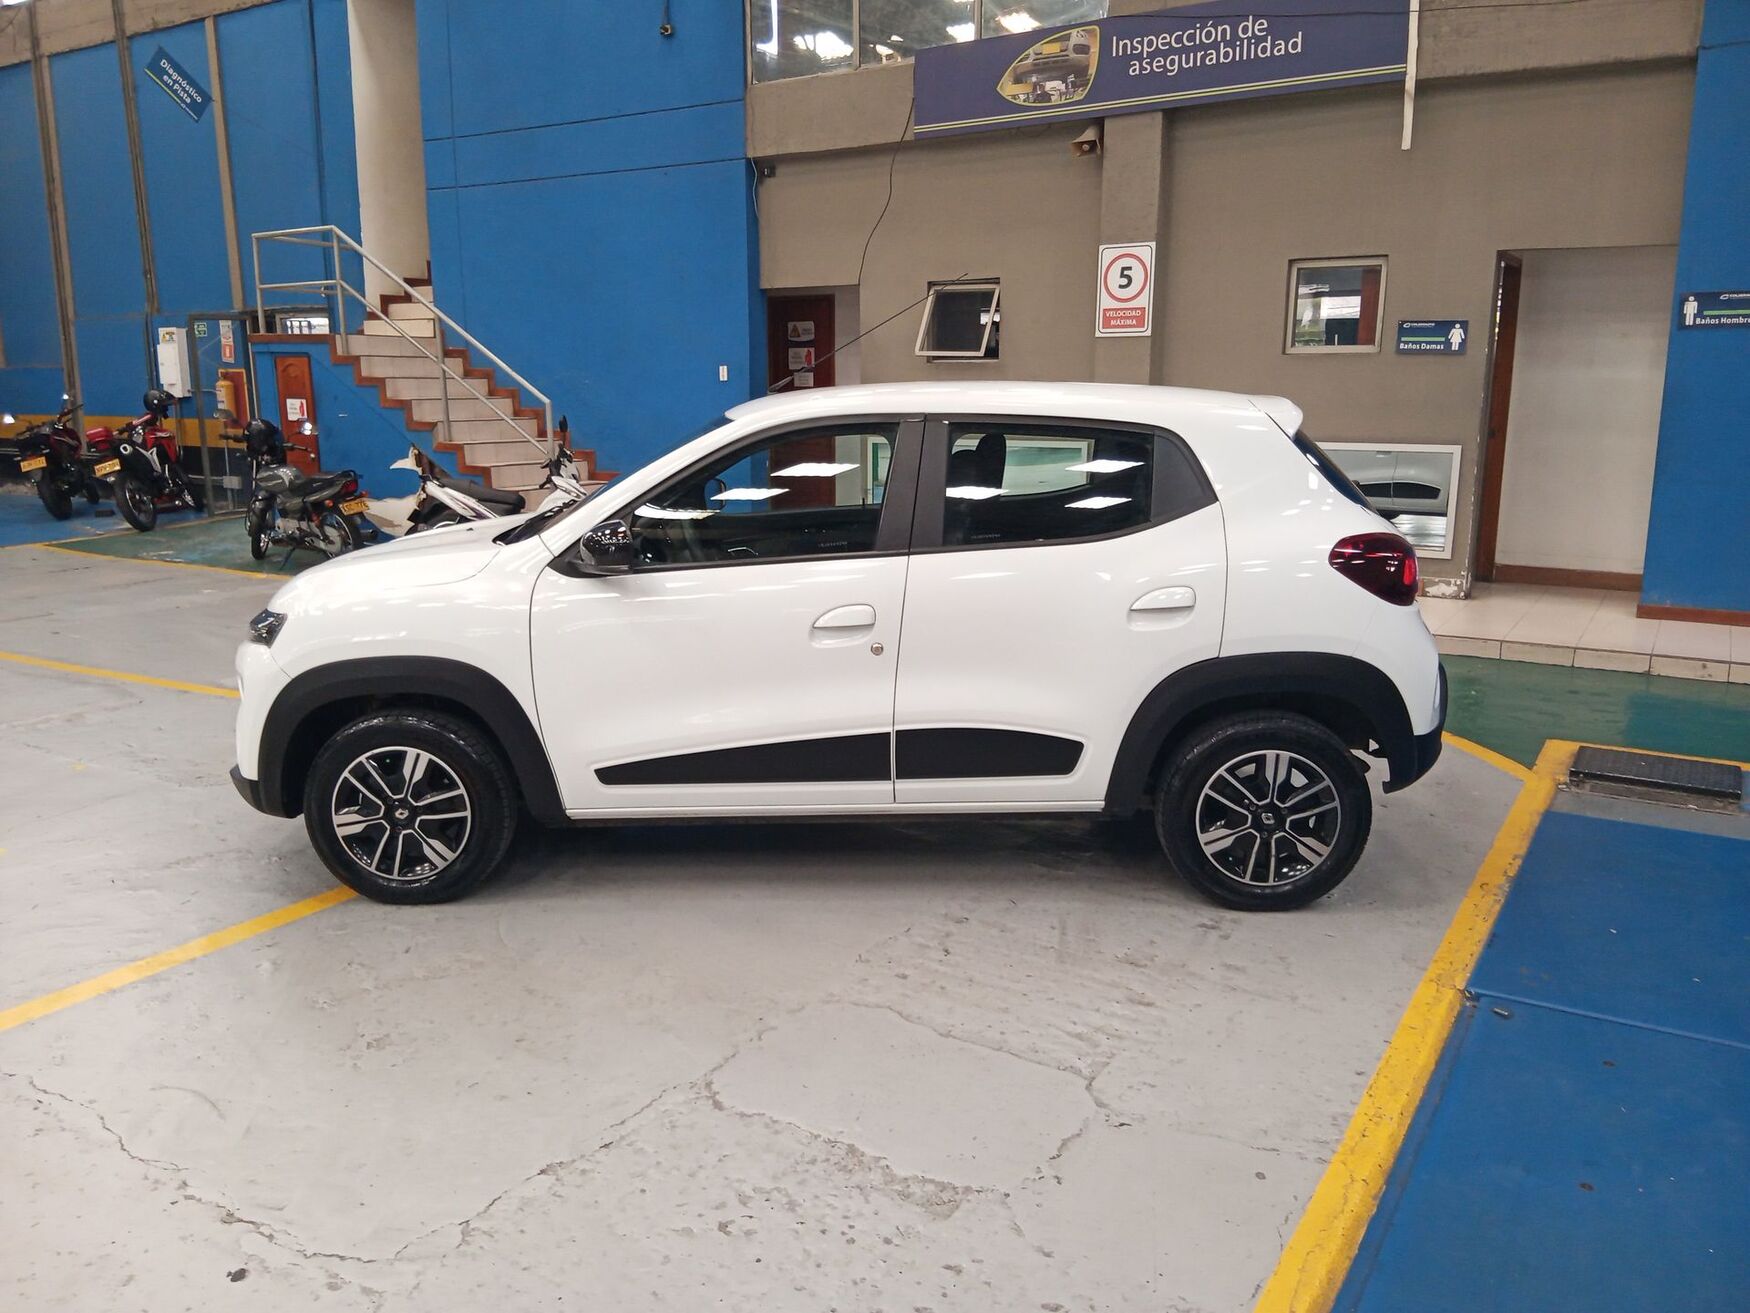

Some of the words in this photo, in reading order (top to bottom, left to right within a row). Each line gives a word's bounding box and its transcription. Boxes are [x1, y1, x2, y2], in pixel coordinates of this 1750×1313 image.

[1112, 20, 1231, 58] Inspección
[1237, 14, 1269, 39] de
[1128, 30, 1303, 76] asegurabilidad
[160, 59, 202, 103] Diagnóstico
[162, 75, 174, 86] en
[173, 83, 191, 104] Pista
[1118, 266, 1133, 289] 5
[1110, 318, 1137, 326] MÁXIMA
[1696, 317, 1719, 325] Baños
